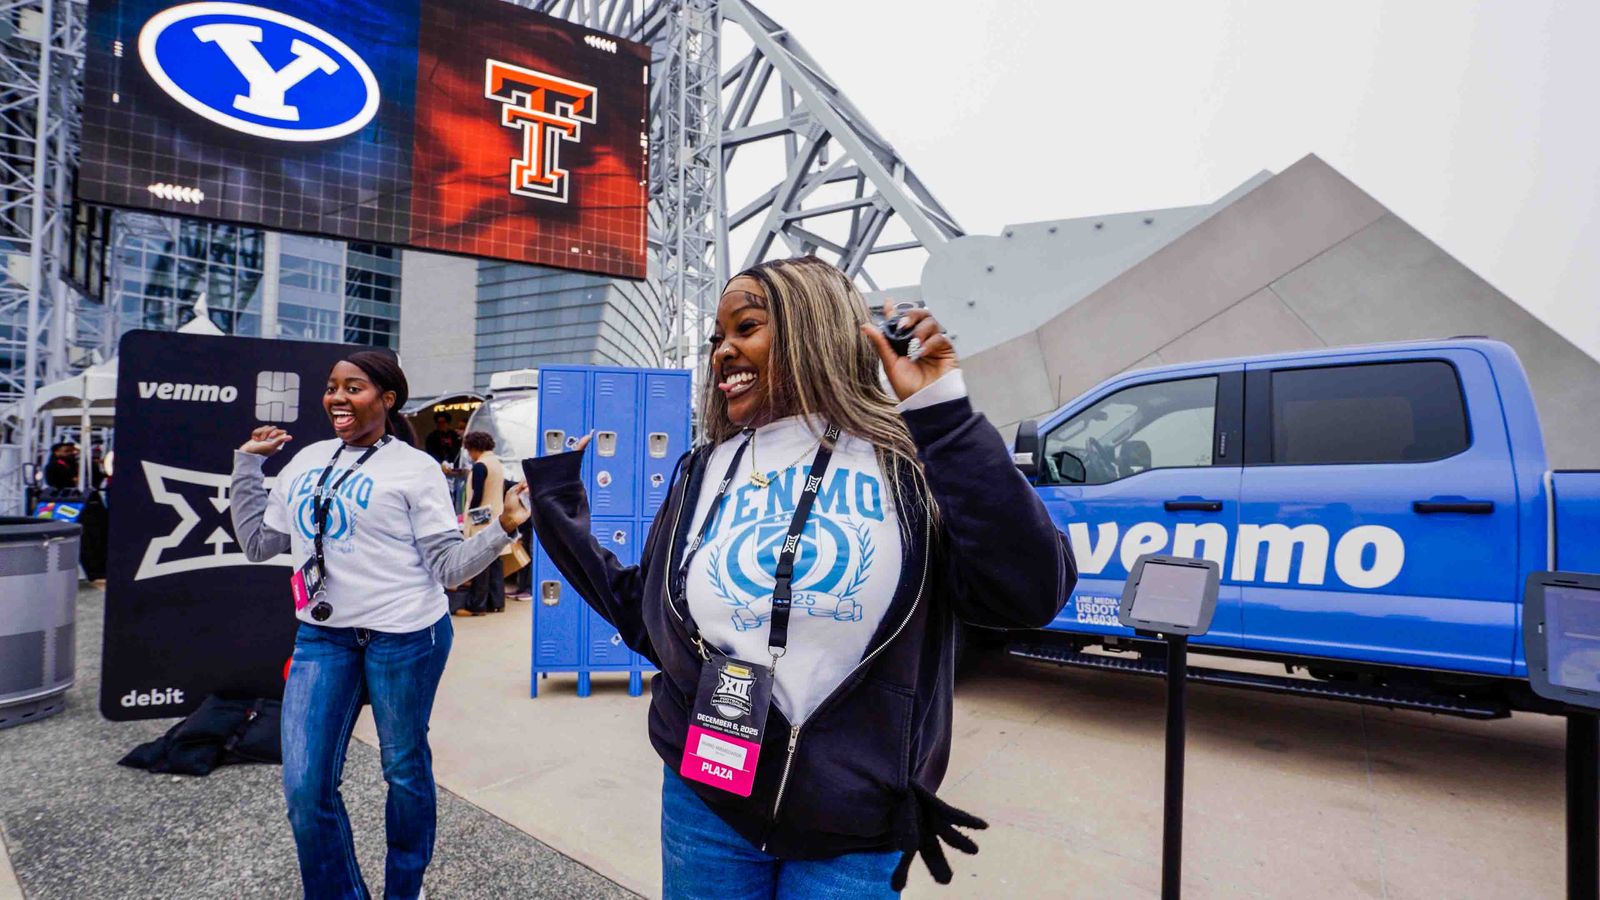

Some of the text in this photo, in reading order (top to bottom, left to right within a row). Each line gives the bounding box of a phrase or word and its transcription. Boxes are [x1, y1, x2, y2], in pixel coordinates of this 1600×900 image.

[192, 23, 340, 121] Y
[138, 381, 238, 403] venmo
[703, 465, 885, 549] VENMO
[1068, 521, 1405, 589] venmo
[1077, 613, 1124, 627] CA6039
[120, 687, 184, 707] debit
[716, 673, 754, 701] XII
[697, 713, 733, 729] DECEMBER
[740, 725, 759, 736] 2025
[701, 761, 734, 781] PLAZA
